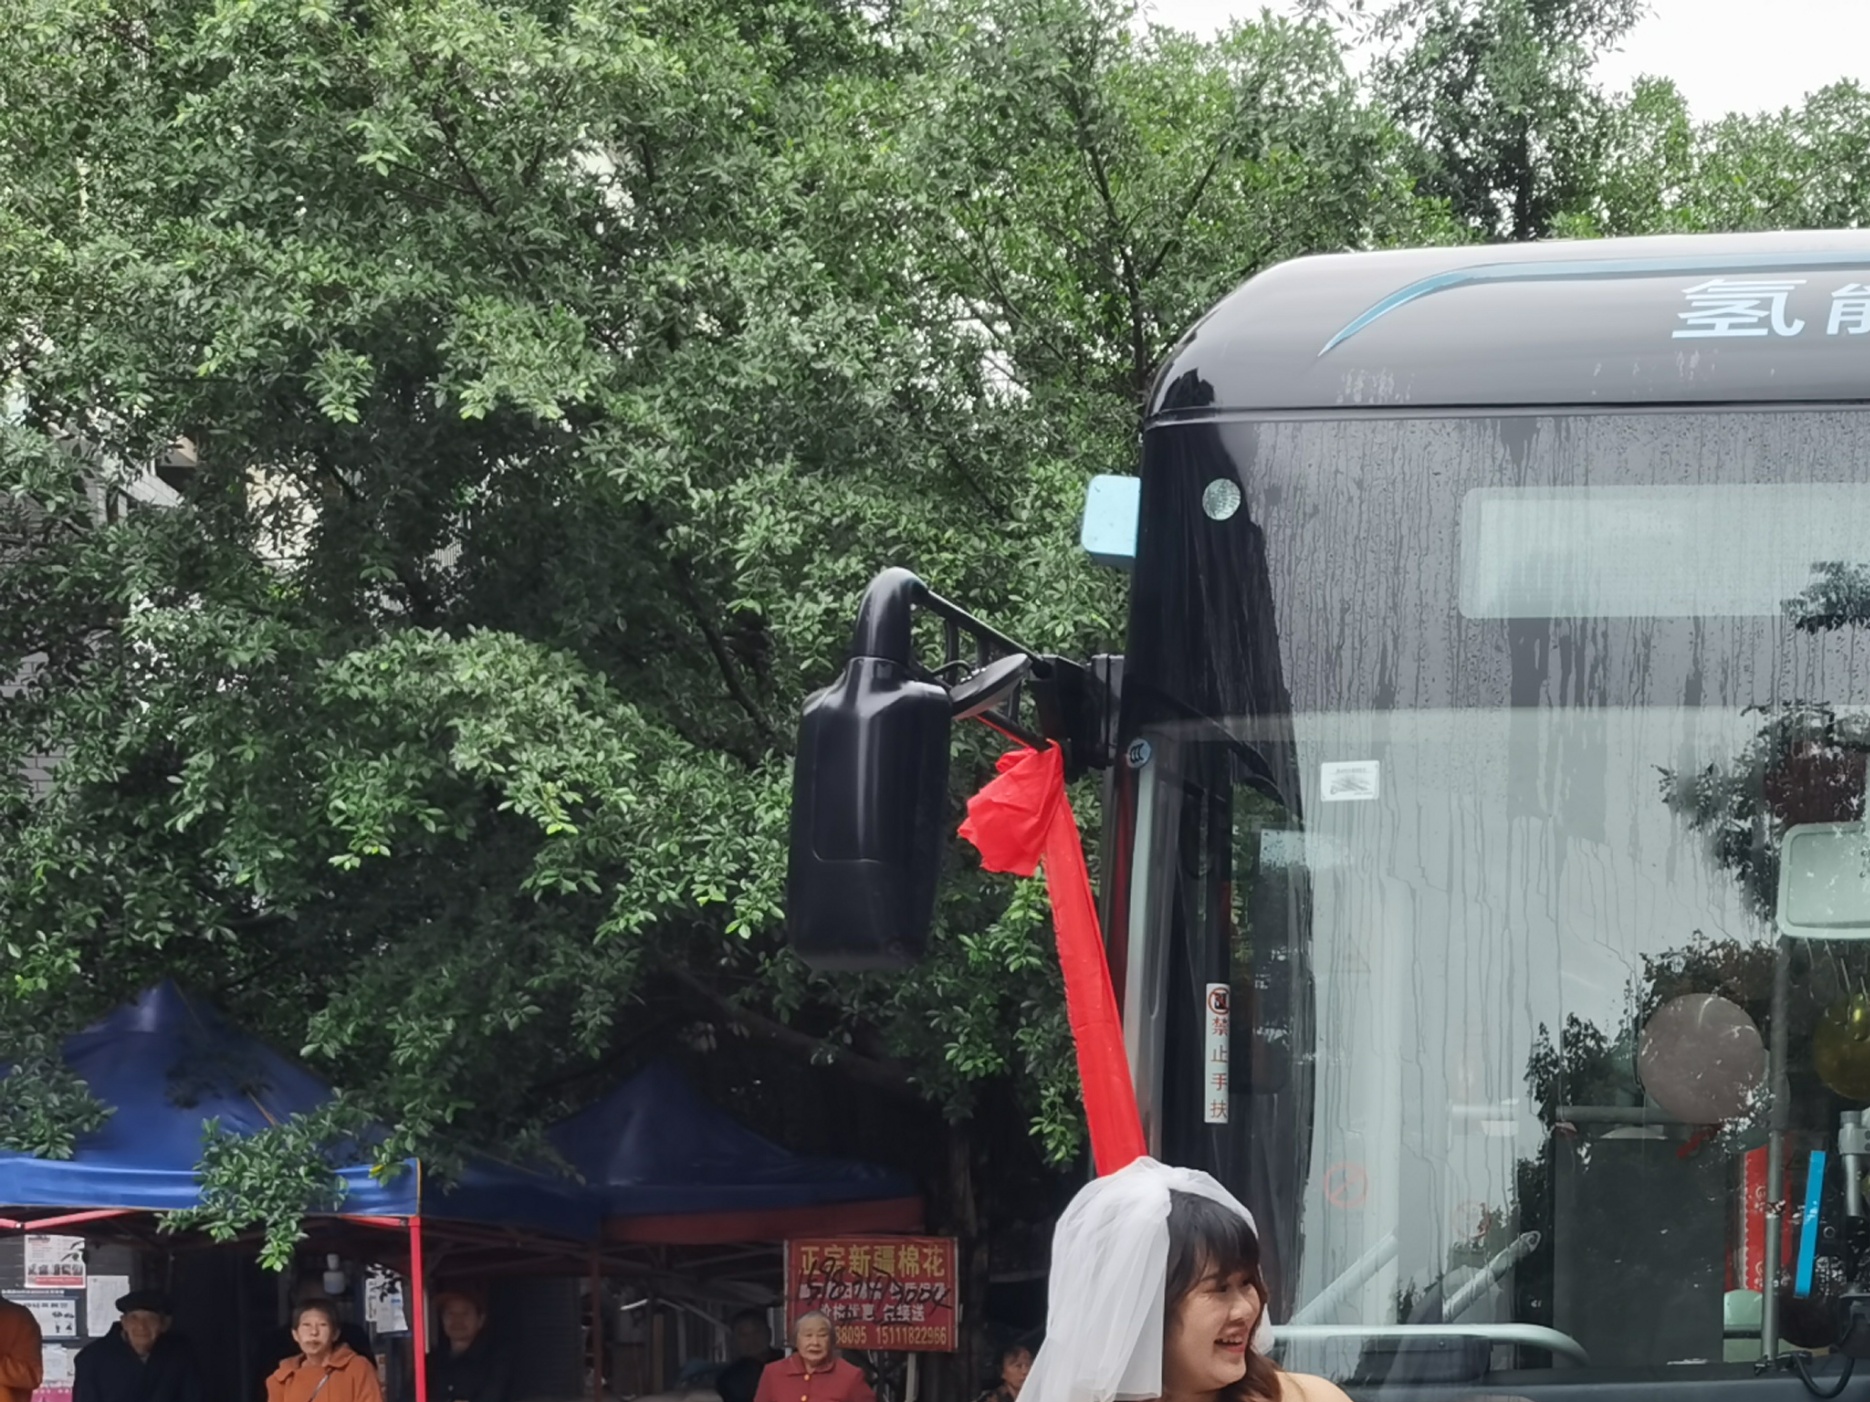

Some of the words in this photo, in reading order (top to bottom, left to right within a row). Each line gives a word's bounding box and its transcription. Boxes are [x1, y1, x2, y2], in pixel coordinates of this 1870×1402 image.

[1210, 1017, 1228, 1119] 禁止手扶
[799, 1244, 946, 1278] 正宗新疆棉花
